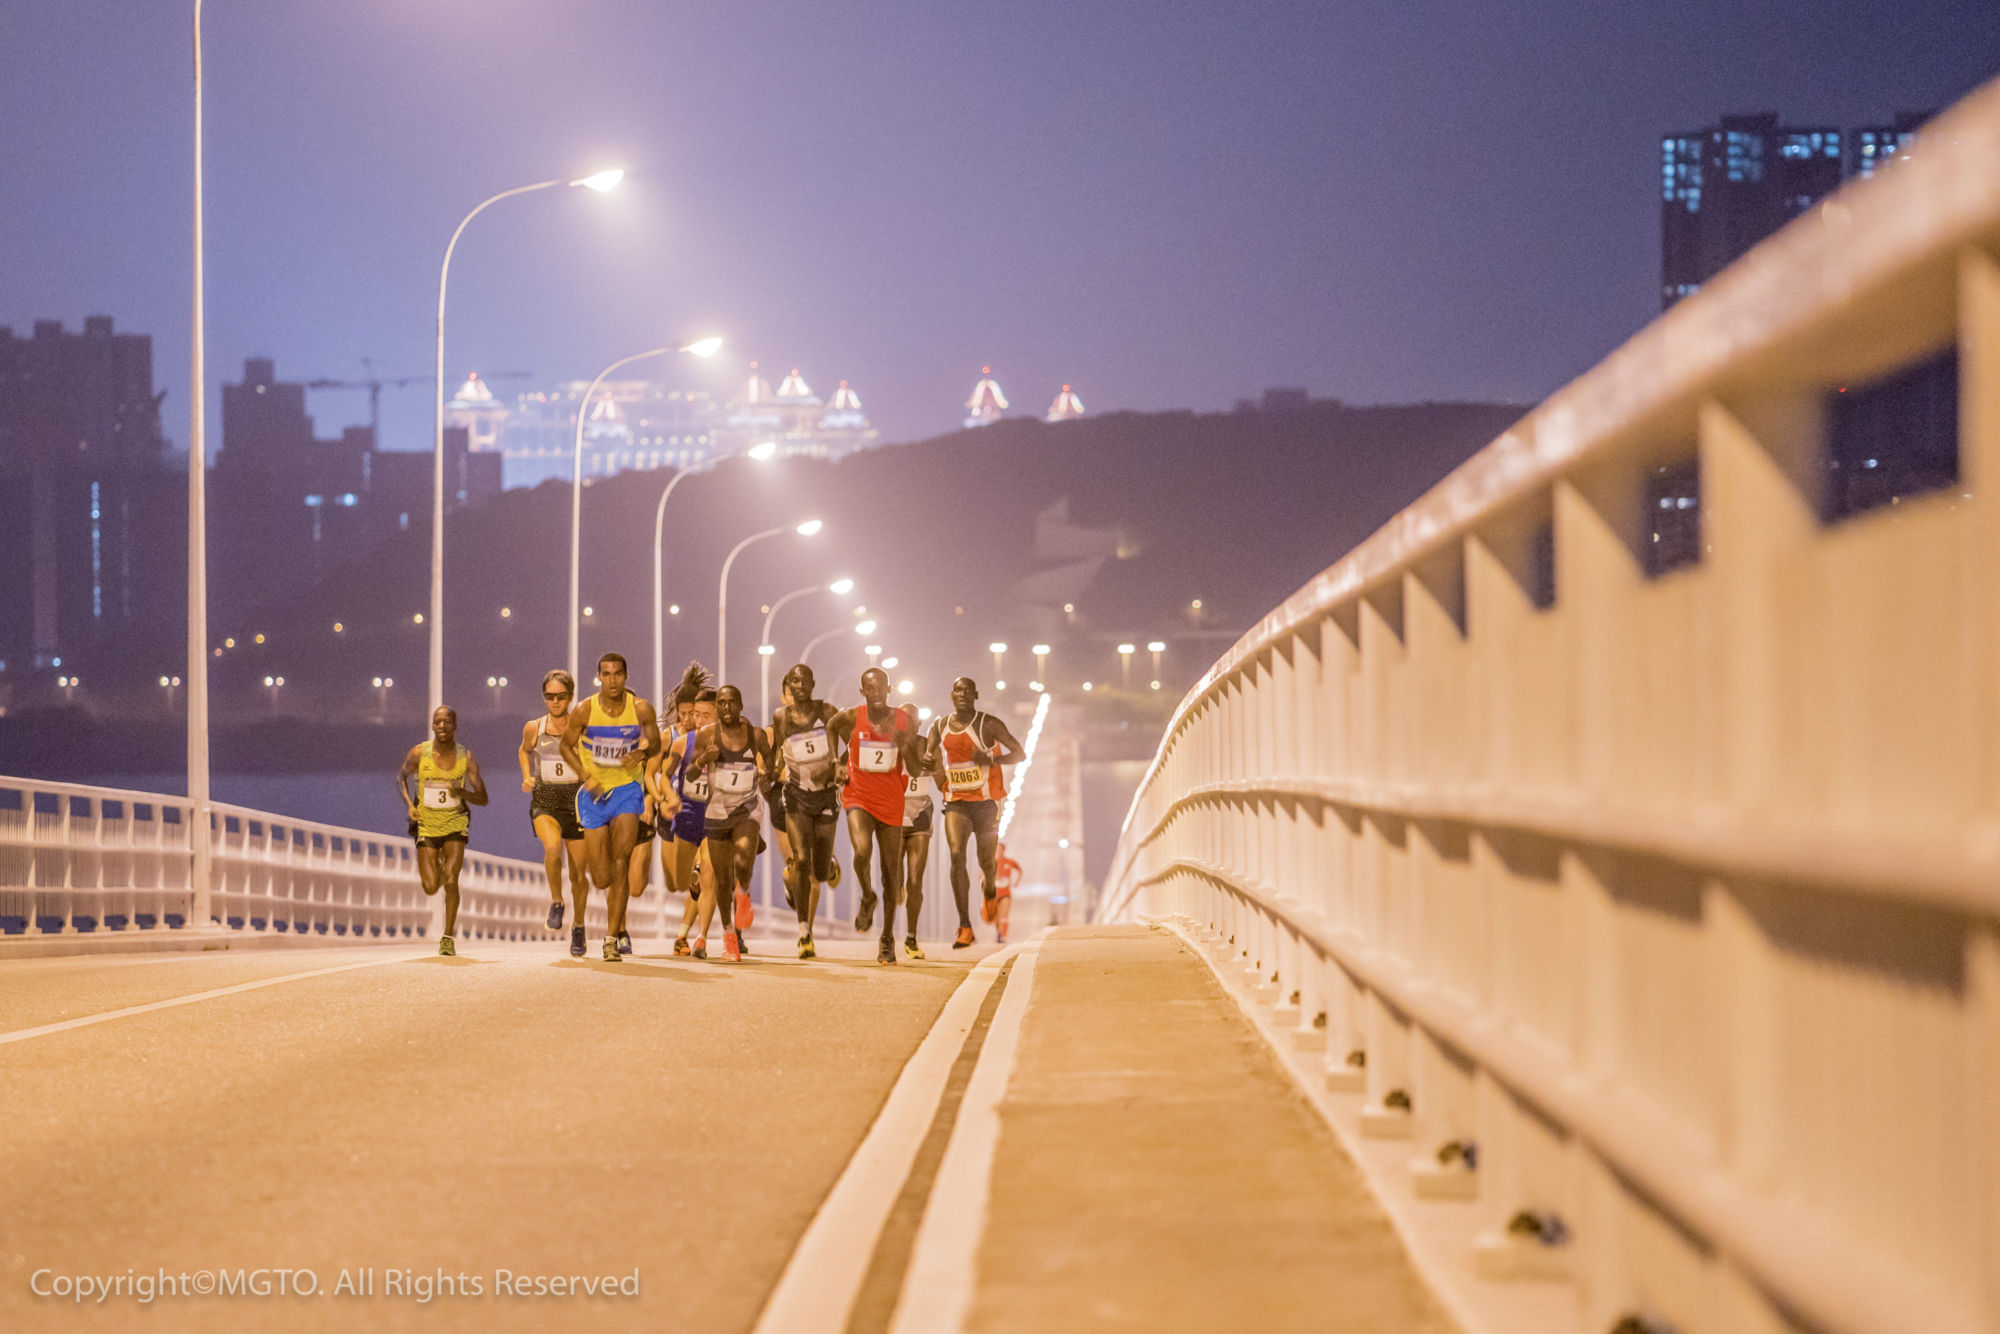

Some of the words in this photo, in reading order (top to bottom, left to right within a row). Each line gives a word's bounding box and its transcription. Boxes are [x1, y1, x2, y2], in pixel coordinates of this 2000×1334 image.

[804, 740, 815, 754] 5
[874, 750, 884, 764] 2
[555, 763, 564, 776] 8
[731, 772, 739, 786] 7
[909, 778, 918, 792] 6
[694, 783, 708, 796] 11
[438, 791, 447, 804] 3
